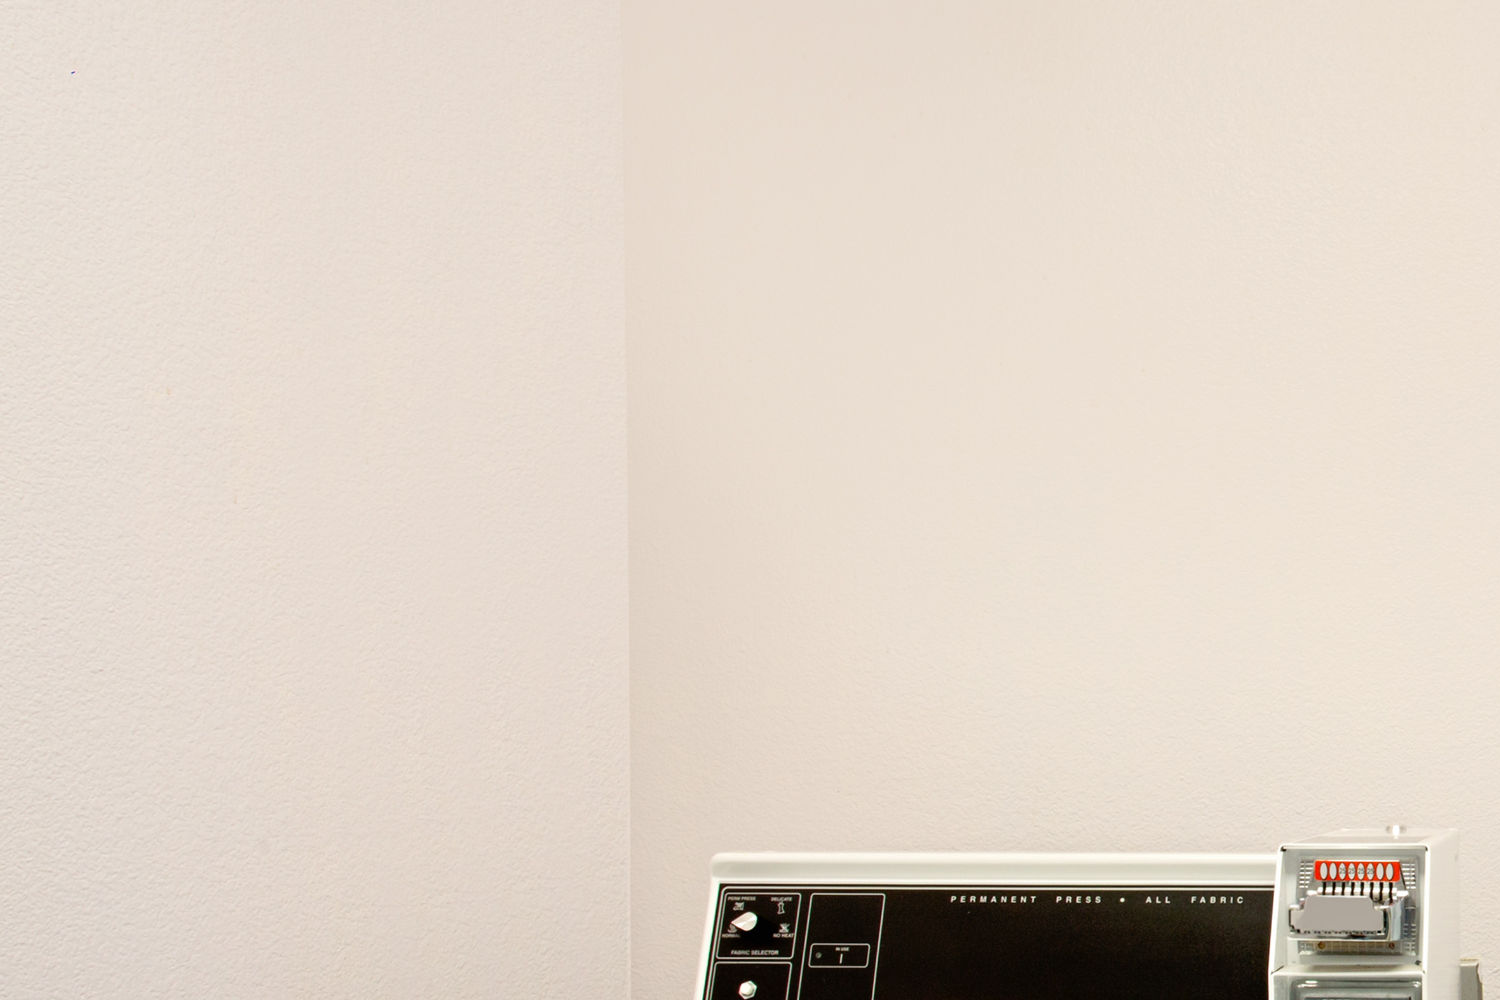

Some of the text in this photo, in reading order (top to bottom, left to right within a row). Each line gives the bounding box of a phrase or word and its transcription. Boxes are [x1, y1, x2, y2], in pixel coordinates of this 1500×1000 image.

[950, 895, 1244, 904] PERMANENT PRESS ALL FABRIC
